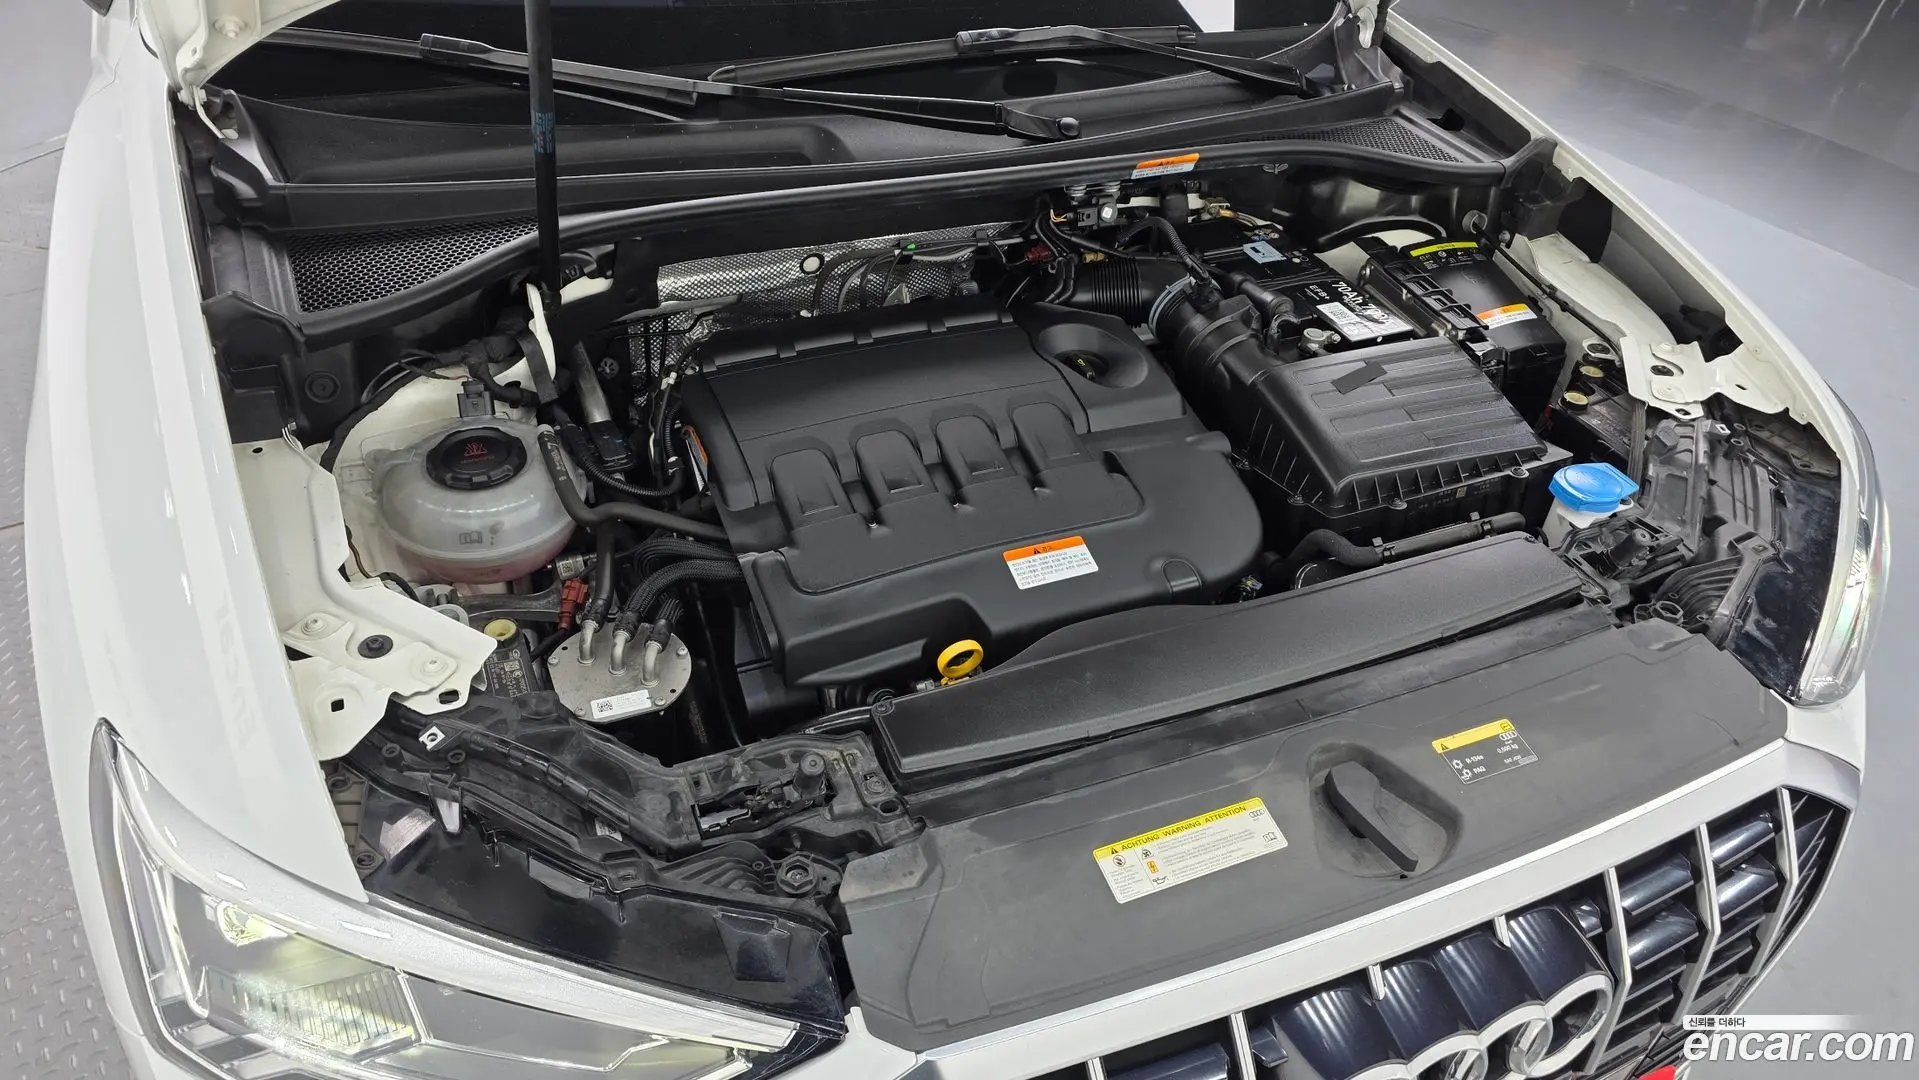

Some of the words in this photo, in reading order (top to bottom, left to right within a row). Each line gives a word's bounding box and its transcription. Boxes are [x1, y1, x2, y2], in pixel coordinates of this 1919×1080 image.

[1332, 282, 1363, 304] 70Ah
[1121, 834, 1160, 851] ACHTUNG
[1162, 821, 1201, 837] WARNING
[1204, 806, 1247, 823] ATTENTION
